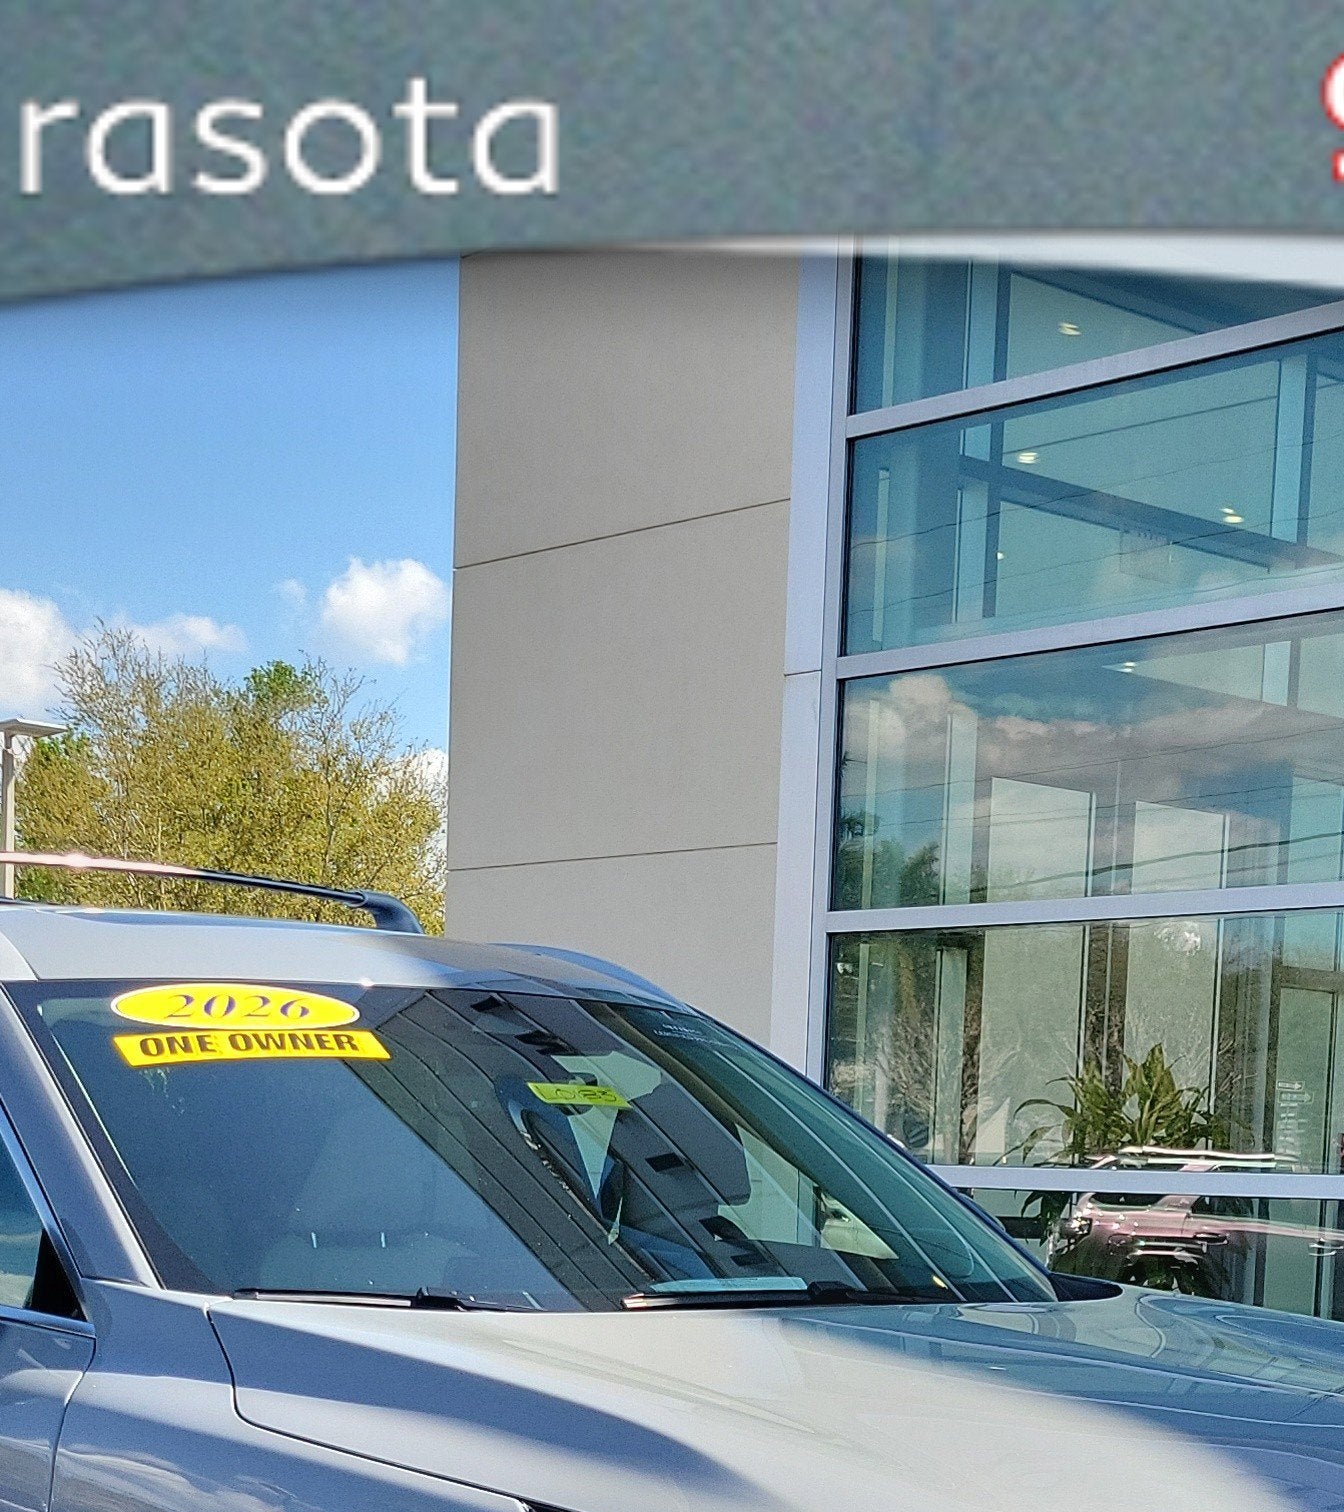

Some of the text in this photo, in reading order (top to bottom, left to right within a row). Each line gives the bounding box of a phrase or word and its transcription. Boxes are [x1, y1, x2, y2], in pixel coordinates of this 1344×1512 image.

[166, 993, 310, 1020] 2026
[139, 1032, 360, 1058] ONE OWNER
